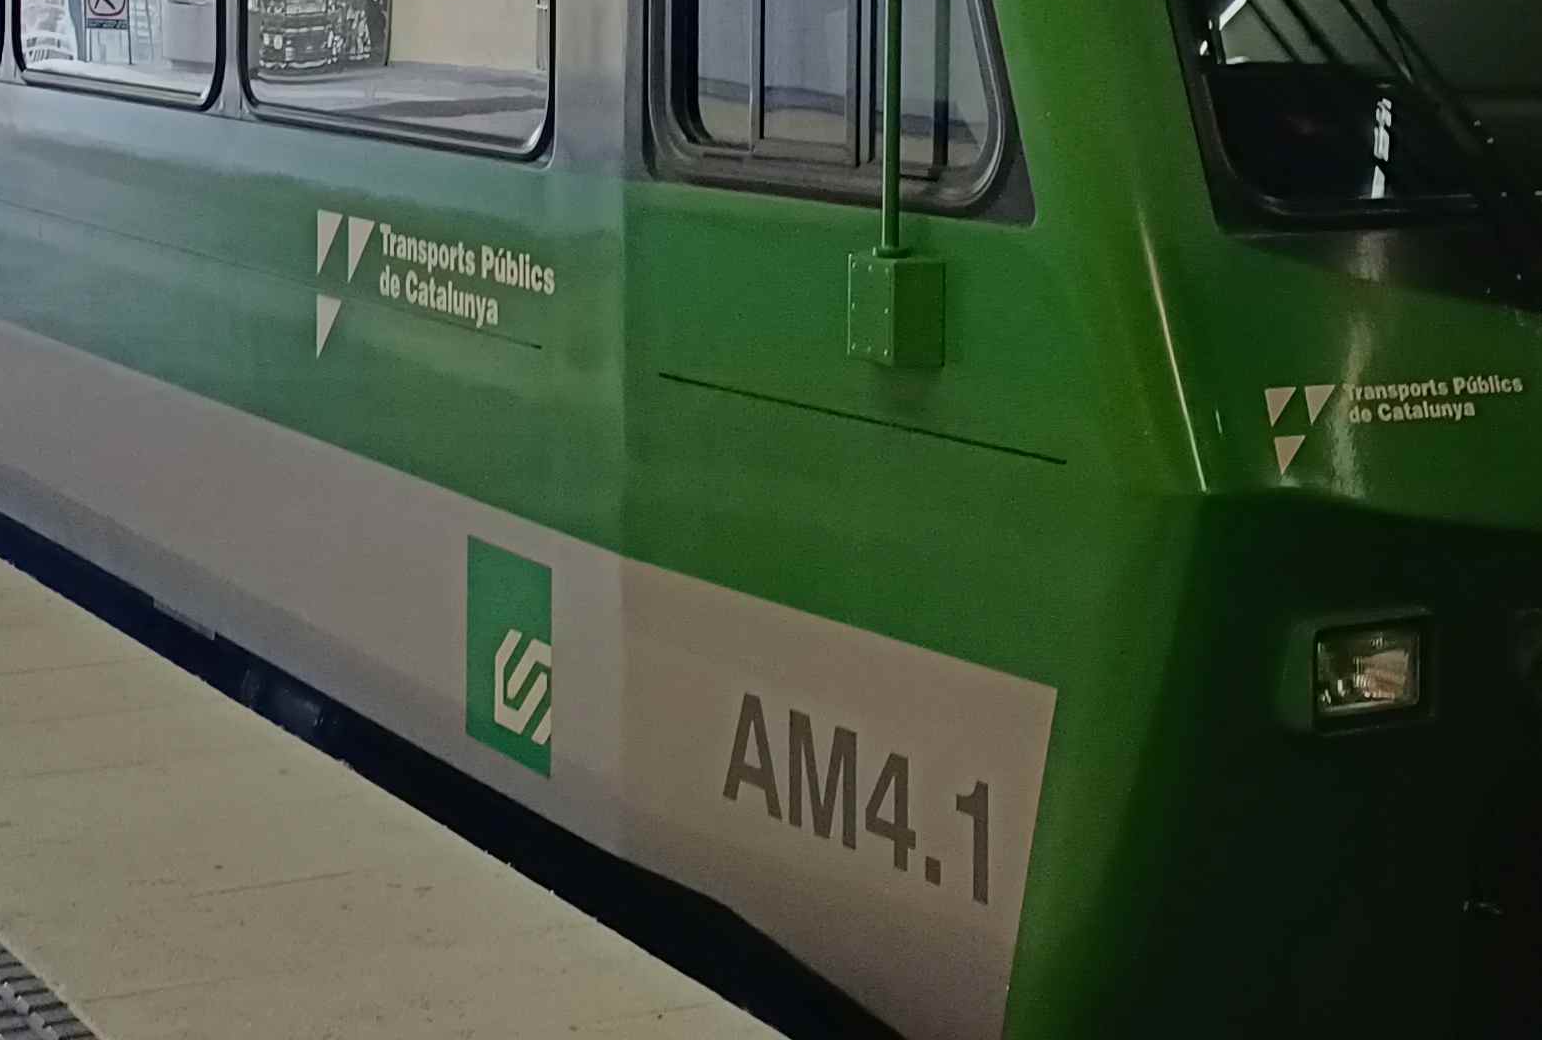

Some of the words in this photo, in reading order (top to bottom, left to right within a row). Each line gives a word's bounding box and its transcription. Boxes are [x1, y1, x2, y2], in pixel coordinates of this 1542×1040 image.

[379, 223, 476, 277] Transports
[481, 244, 555, 296] Públics
[379, 265, 400, 299] de
[405, 272, 499, 329] Catalunya
[1343, 379, 1448, 401] Transports
[1452, 374, 1523, 395] Públics
[1349, 405, 1372, 423] de
[1377, 400, 1476, 422] Catalunya
[722, 692, 989, 905] AM4.1
